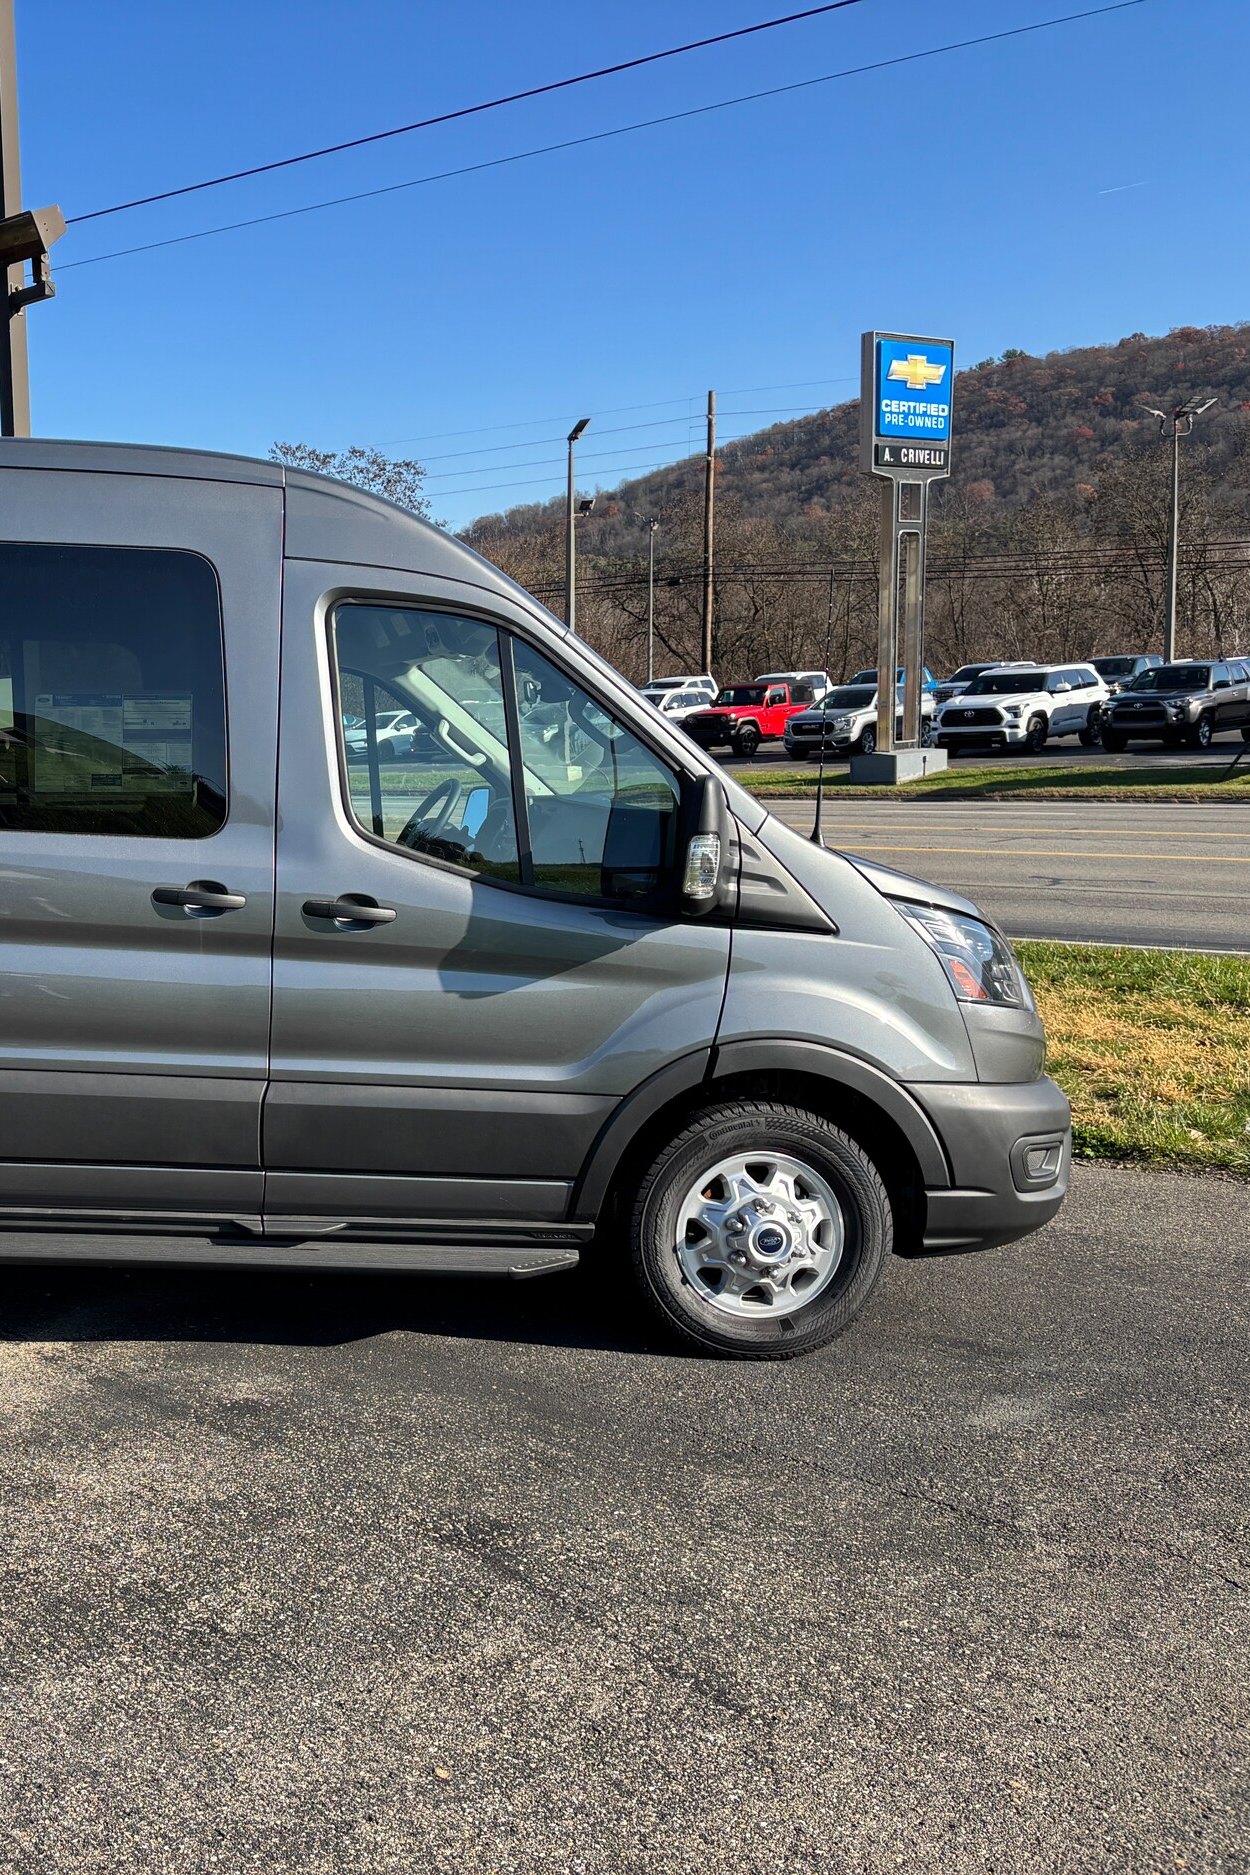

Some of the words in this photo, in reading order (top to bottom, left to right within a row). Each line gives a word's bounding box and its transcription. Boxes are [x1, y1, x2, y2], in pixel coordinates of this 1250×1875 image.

[881, 399, 949, 416] CERTIFIED
[885, 414, 945, 428] PRE-OWNED
[884, 447, 894, 462] A.
[900, 447, 945, 465] CRIVELLI
[708, 1119, 754, 1140] Continental
